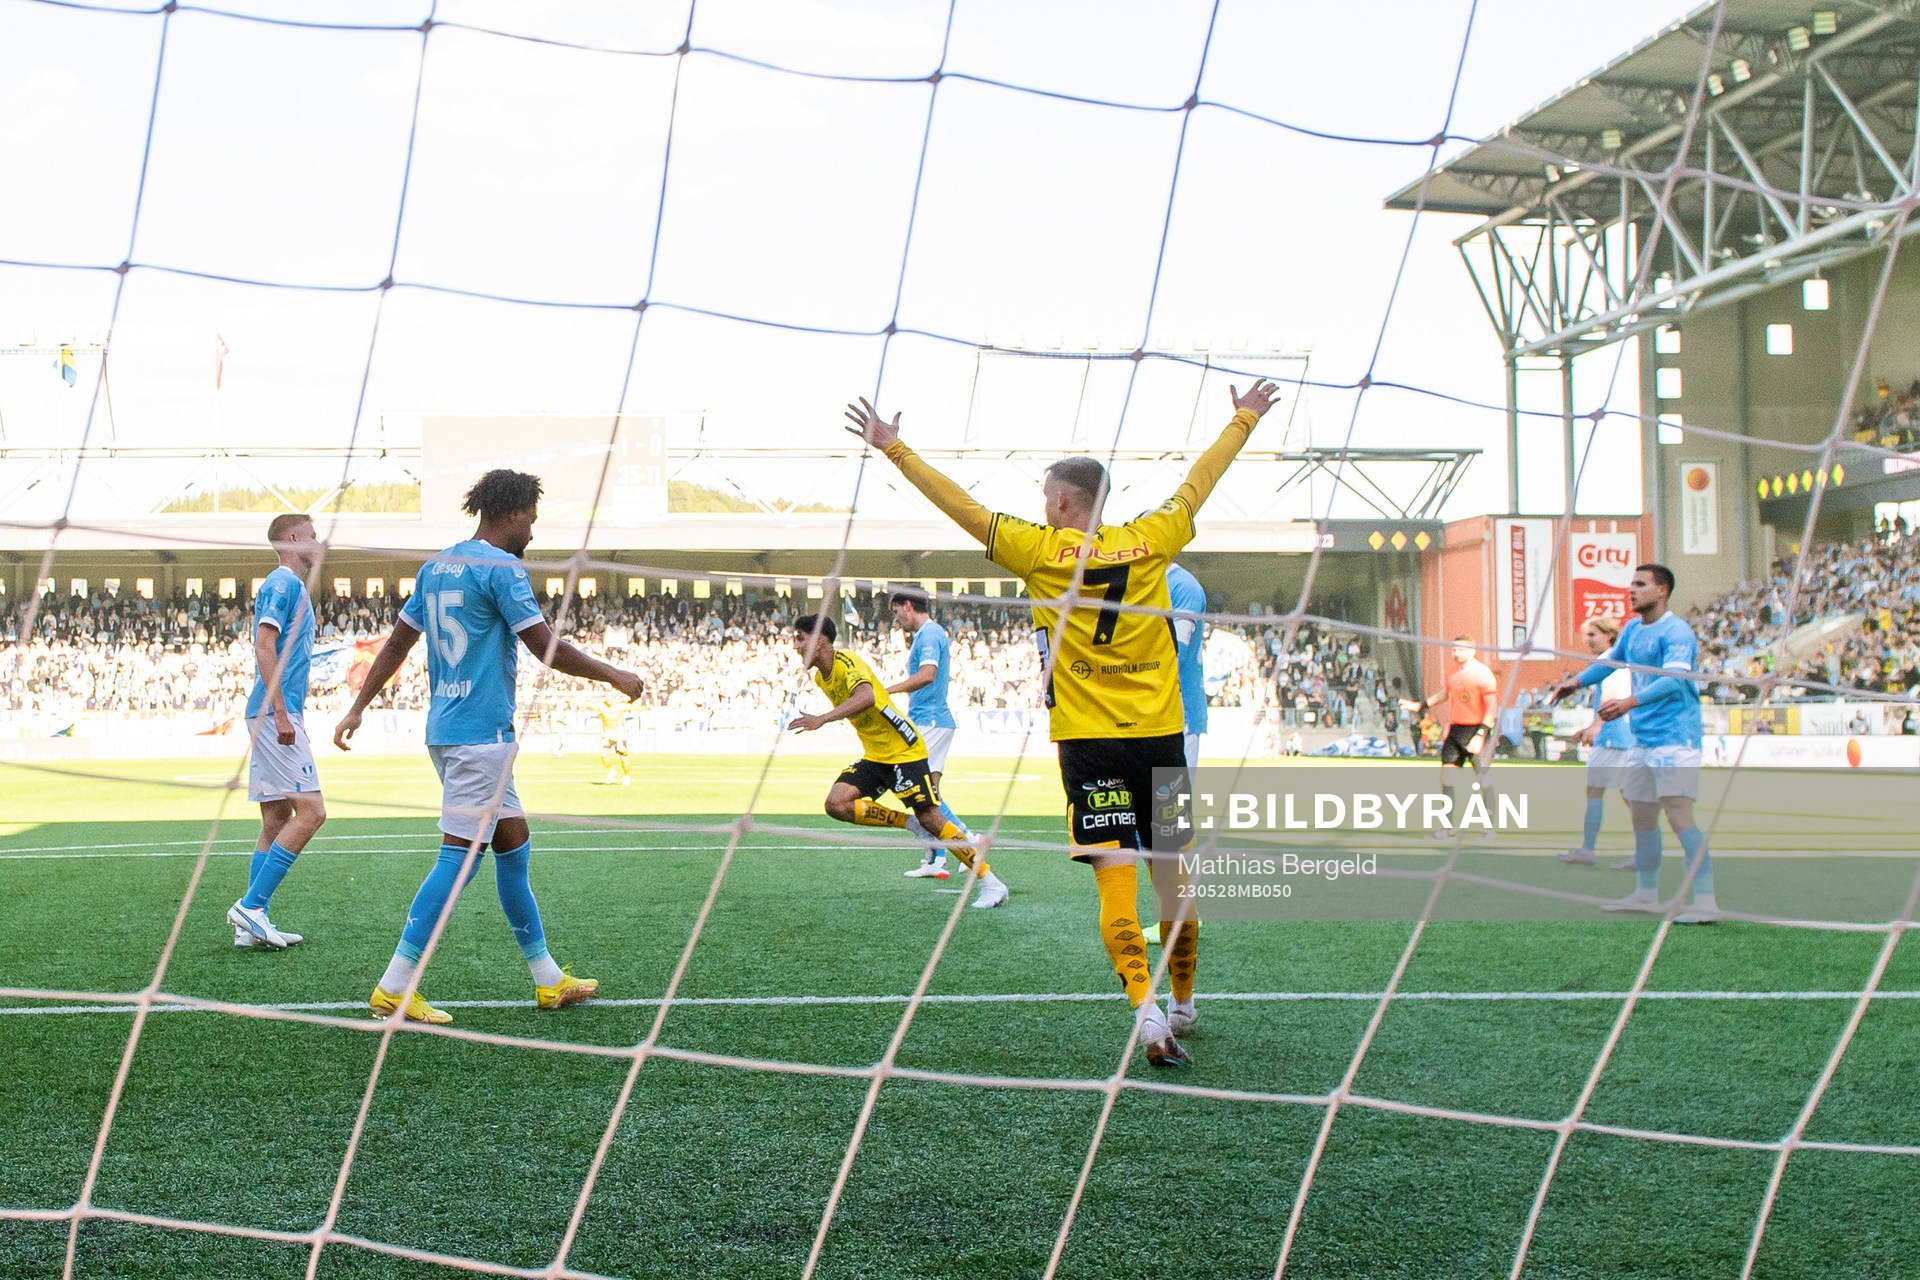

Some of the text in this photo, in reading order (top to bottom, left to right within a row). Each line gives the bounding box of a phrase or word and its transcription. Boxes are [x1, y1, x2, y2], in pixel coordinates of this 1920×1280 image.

[1578, 544, 1630, 568] City
[1083, 564, 1130, 646] 7
[1584, 601, 1626, 617] 7-23
[424, 589, 469, 669] 15
[1101, 663, 1138, 675] RUDHOLM
[1093, 790, 1131, 808] EAB
